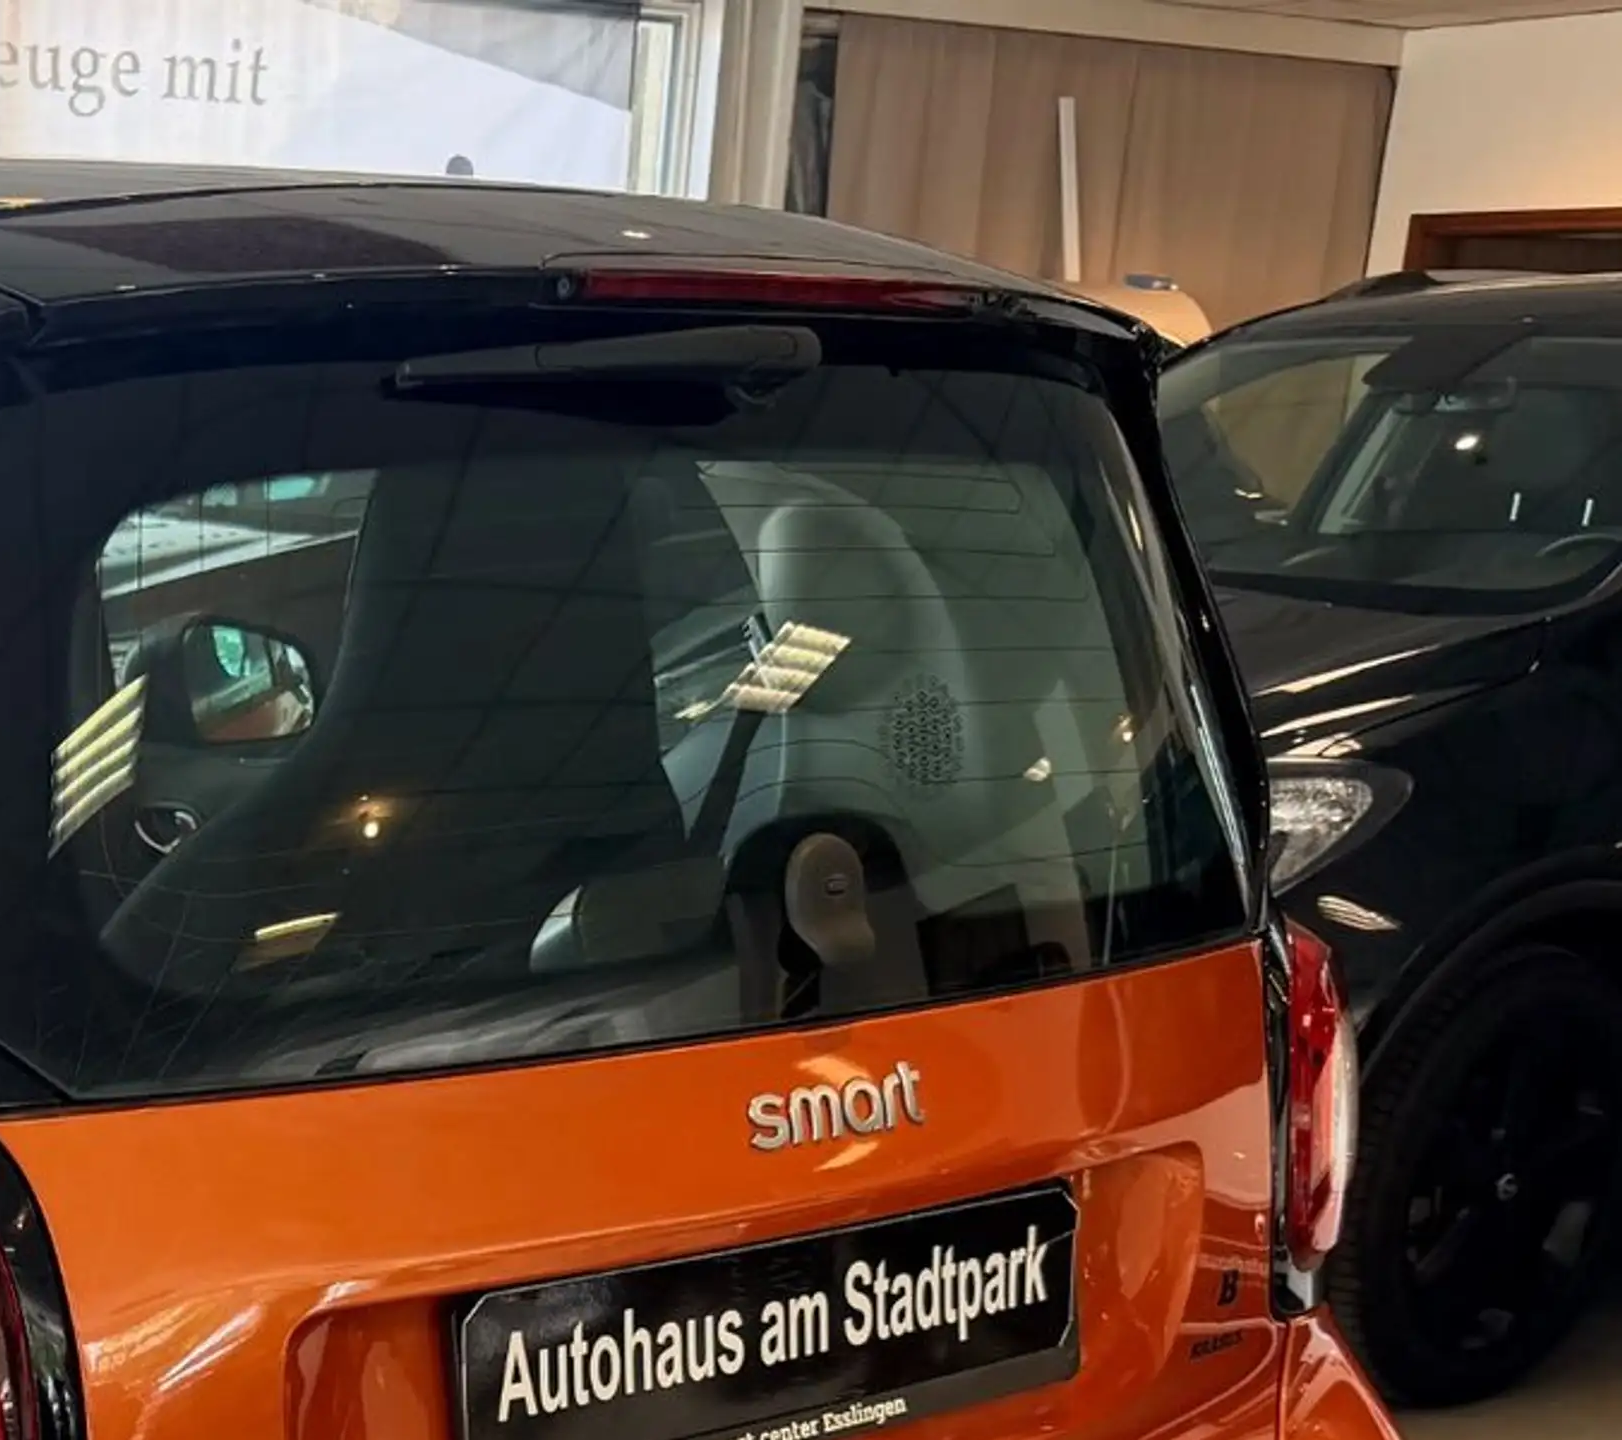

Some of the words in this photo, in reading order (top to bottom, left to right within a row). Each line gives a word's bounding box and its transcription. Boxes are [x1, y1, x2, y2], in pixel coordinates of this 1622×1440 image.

[161, 38, 269, 106] mit
[747, 1060, 926, 1150] smart
[497, 1307, 745, 1423] Autohaus
[760, 1291, 830, 1366] am
[843, 1224, 1048, 1343] Stadtpark
[822, 1397, 908, 1433] Esslingen
